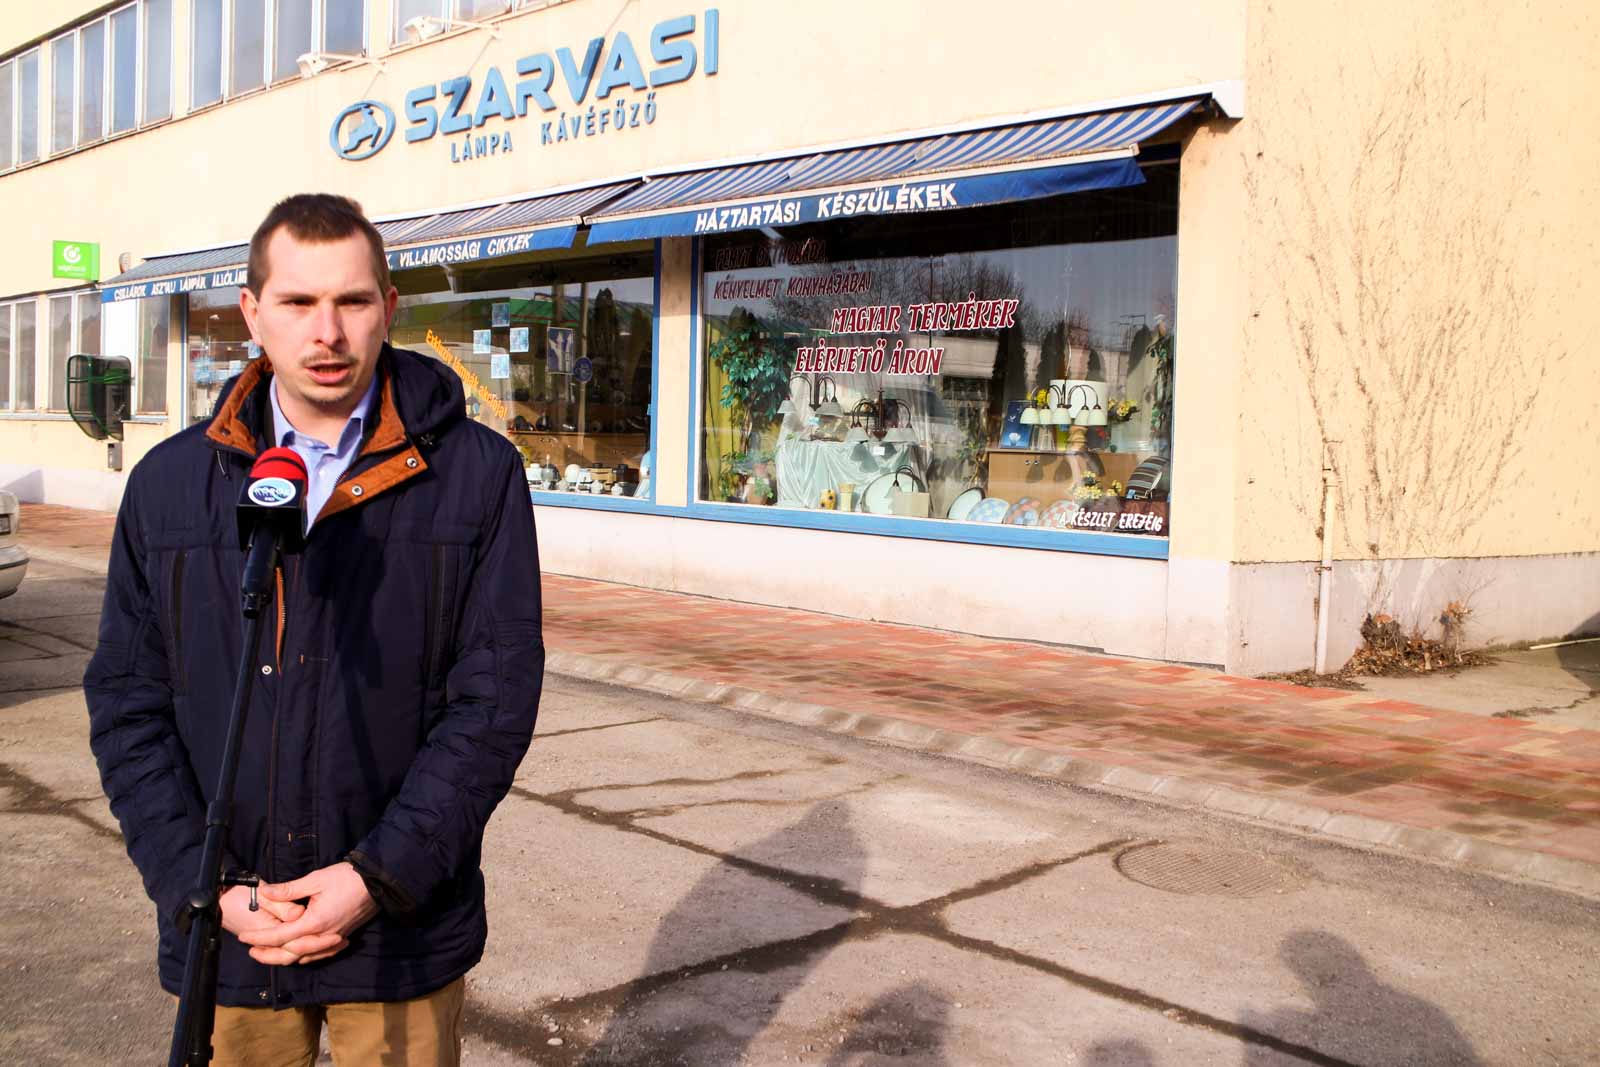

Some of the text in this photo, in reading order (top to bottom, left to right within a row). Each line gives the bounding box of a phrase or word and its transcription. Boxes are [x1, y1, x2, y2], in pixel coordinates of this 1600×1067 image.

[405, 8, 719, 143] SZARVASI
[451, 93, 657, 163] LÁMPA KÁVÉFŐZŐ
[695, 183, 957, 232] HÁZTARTÁSI KÉSZÜLÉKEK
[400, 240, 480, 267] VILLAMOSSÁGI
[487, 233, 534, 256] CIKKEK
[714, 274, 780, 300] KÉNYELMET
[830, 292, 1018, 334] MAGYAR TERMÉKEK
[794, 338, 944, 375] ELÉRHETŐ ÁRON
[1071, 508, 1116, 528] KÉSZLET
[1119, 512, 1163, 532] EREJÉIG
